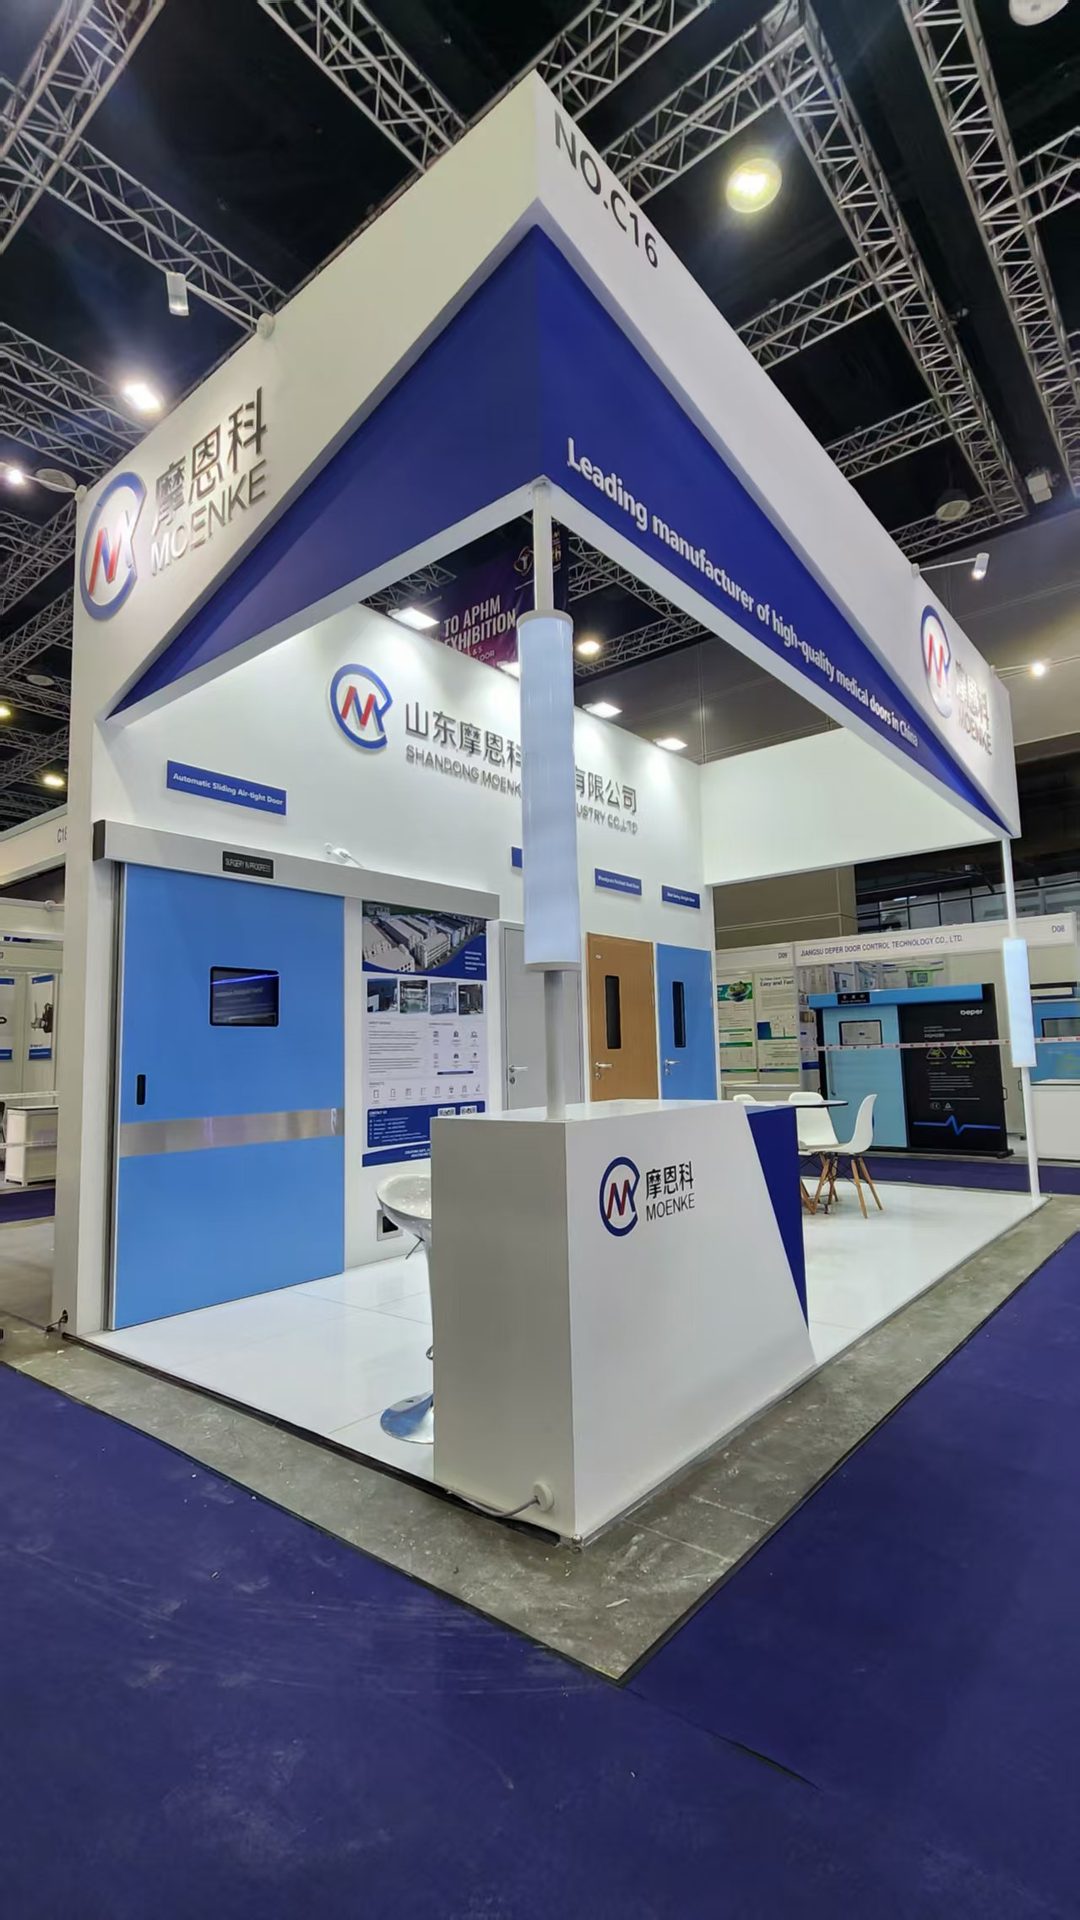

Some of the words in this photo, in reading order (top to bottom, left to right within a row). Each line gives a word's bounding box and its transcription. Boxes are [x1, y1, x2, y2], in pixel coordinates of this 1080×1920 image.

[555, 109, 658, 268] NO.C16
[151, 386, 267, 536] 摩恩科
[151, 459, 267, 576] MOENKE
[444, 615, 459, 637] TO
[463, 595, 501, 629] APHM
[567, 437, 648, 531] Leading
[652, 514, 754, 612] manufacturer
[757, 603, 770, 625] of
[772, 609, 835, 682] high-quality
[836, 668, 869, 707] medical
[870, 694, 892, 725] doors
[891, 711, 899, 732] in
[899, 719, 919, 747] China
[172, 773, 212, 789] Automatic
[212, 782, 237, 796] Sliding
[238, 788, 267, 802] Air-tight
[267, 795, 283, 805] Door
[405, 745, 480, 782] SHANDONG
[481, 769, 522, 799] MOENK
[801, 948, 824, 957] JIANGSU
[825, 946, 843, 955] DEPER
[845, 944, 861, 953] DOOR
[862, 942, 890, 951] CONTROL
[892, 937, 934, 948] TECHNOLOGY
[646, 1161, 694, 1200] 摩恩科
[646, 1193, 696, 1221] MOENKE
